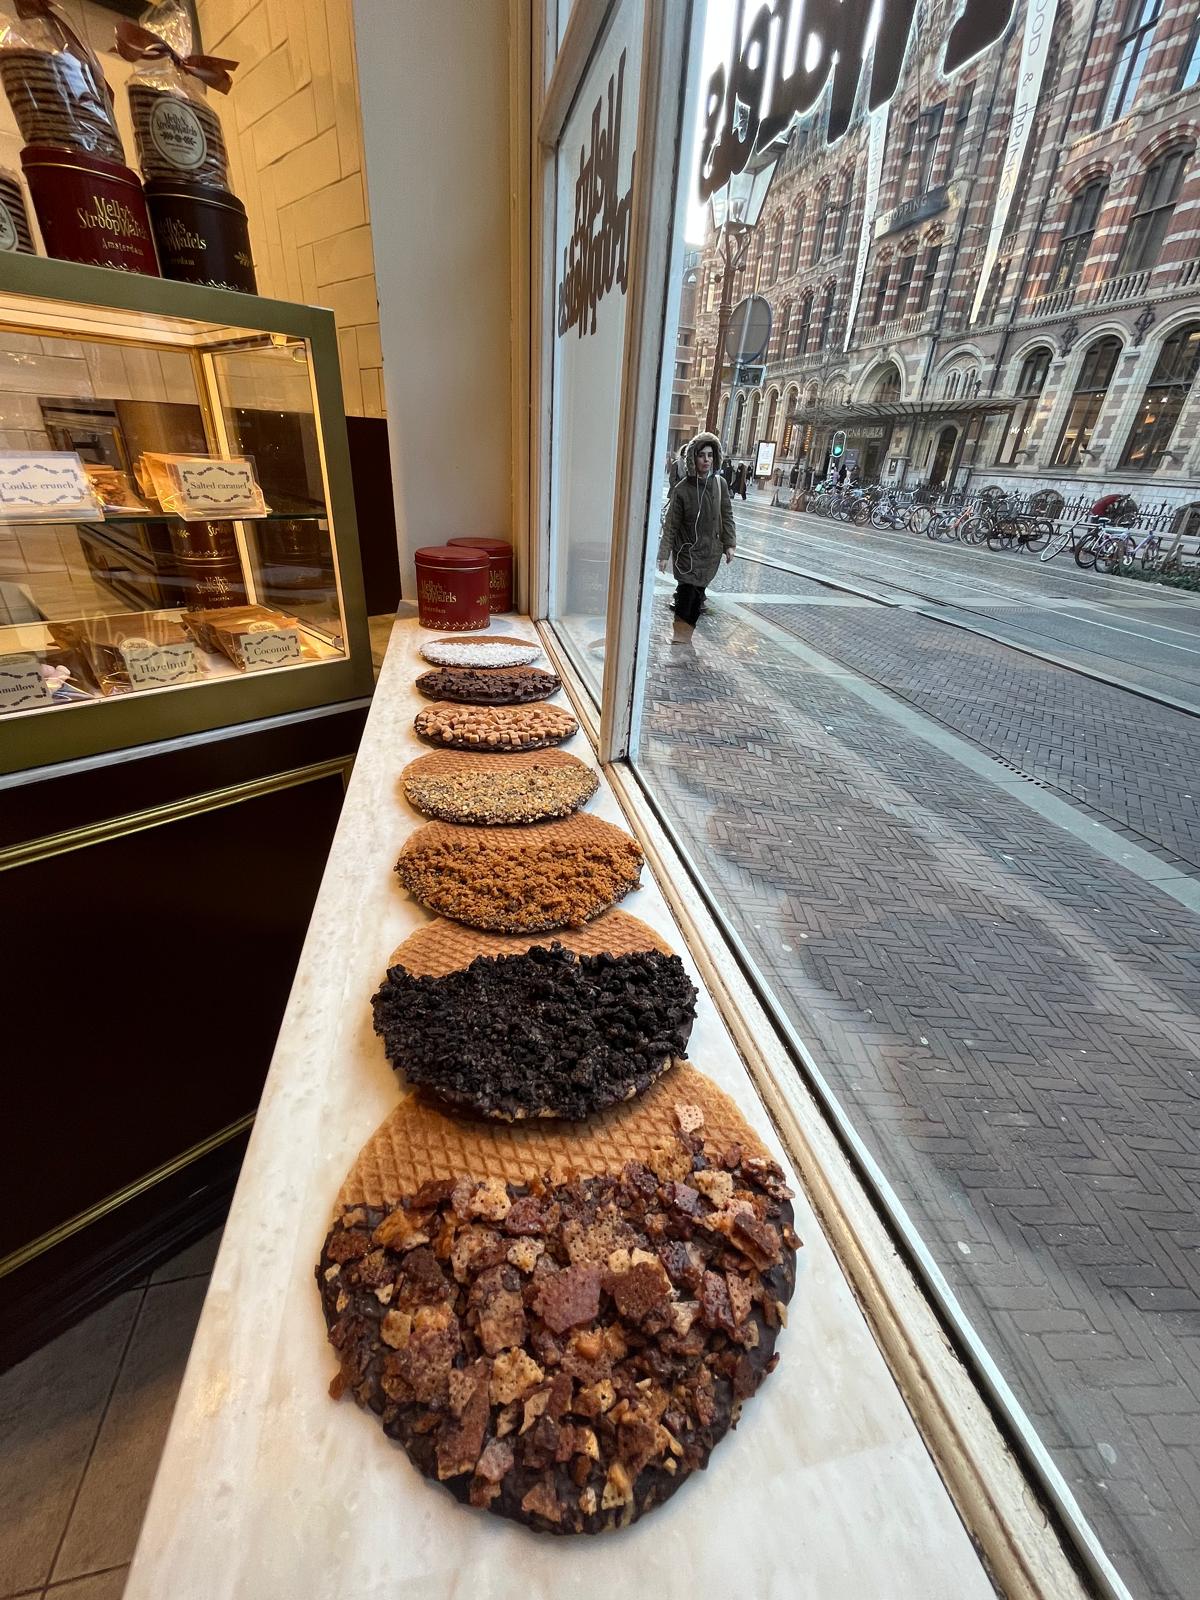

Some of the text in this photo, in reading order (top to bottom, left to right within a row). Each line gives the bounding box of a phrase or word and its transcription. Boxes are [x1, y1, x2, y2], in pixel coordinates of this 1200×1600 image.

[999, 102, 1028, 201] DRINKS
[92, 195, 134, 224] Melly's
[883, 195, 928, 226] SHOPPING
[2, 480, 75, 491] Cookie crunch
[190, 481, 247, 490] Salted caramel
[252, 644, 292, 657] Coconut
[139, 659, 188, 674] Hazelnut
